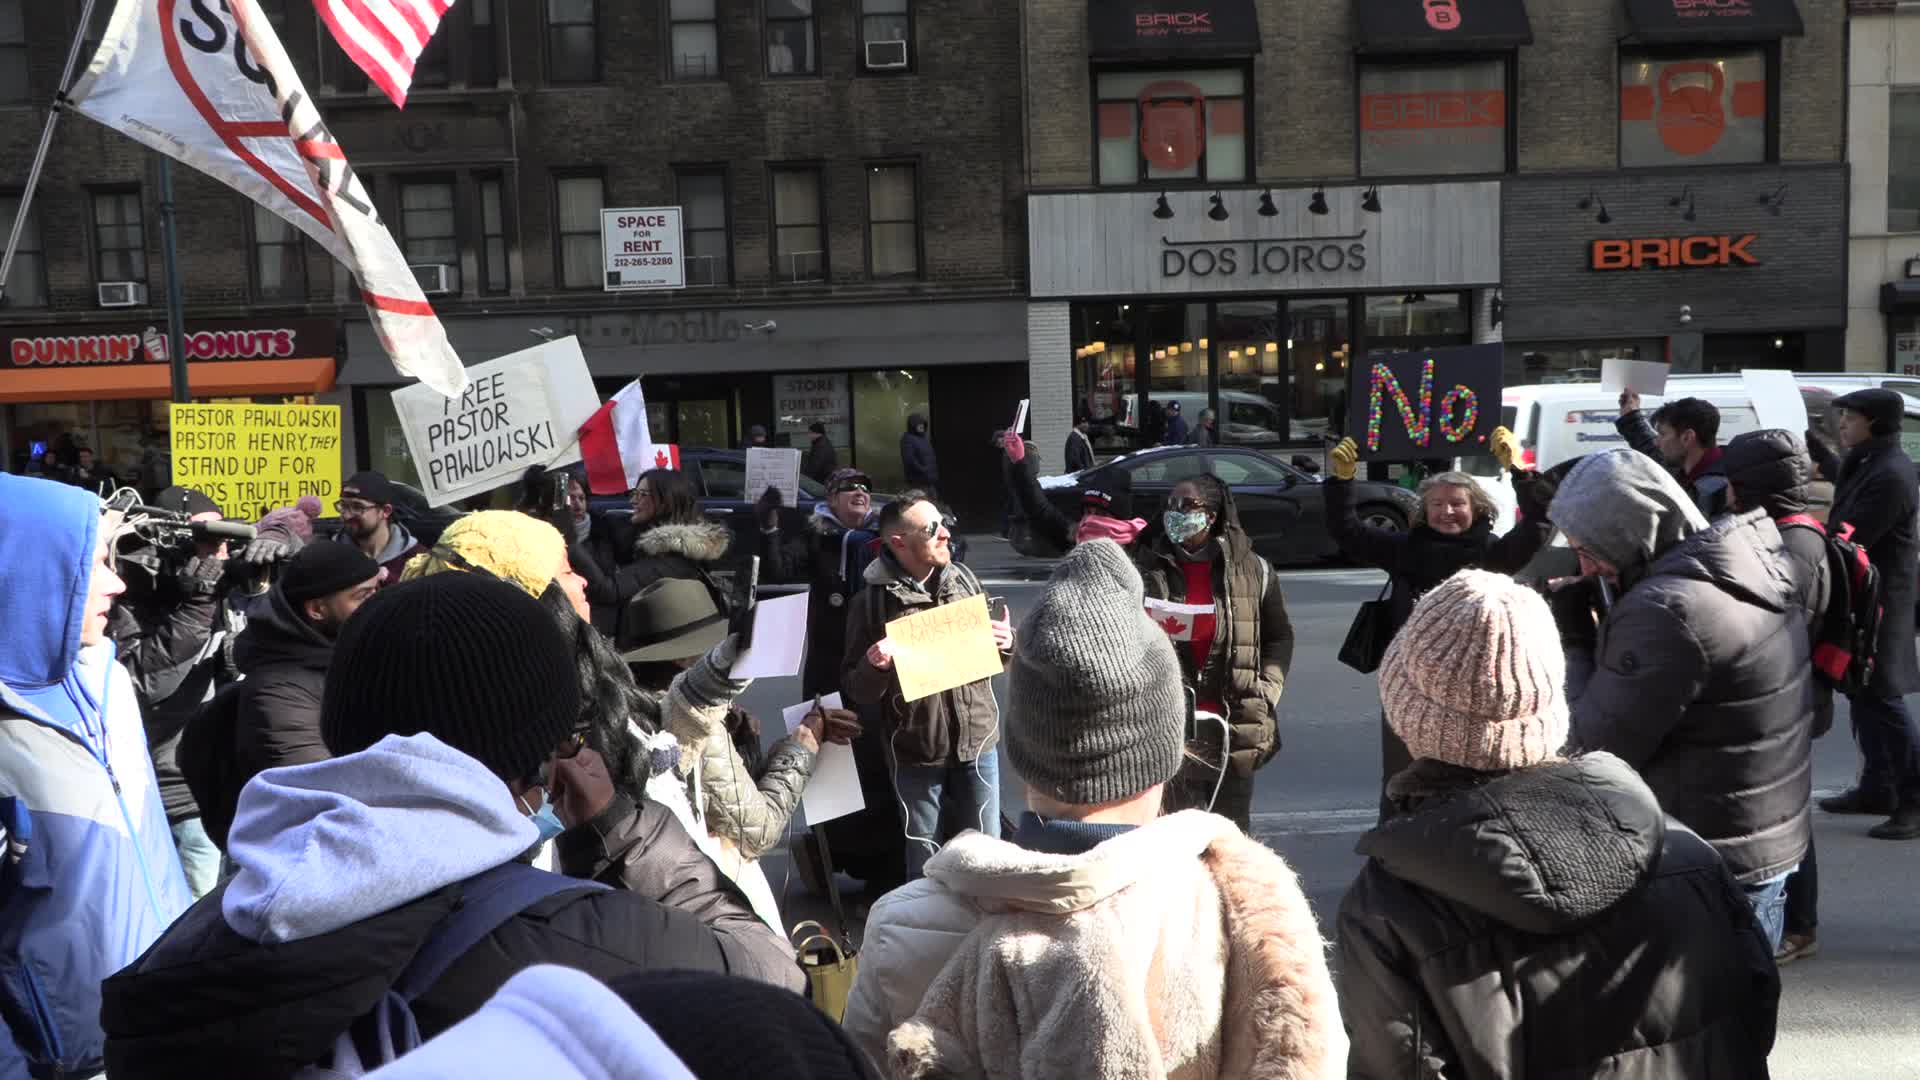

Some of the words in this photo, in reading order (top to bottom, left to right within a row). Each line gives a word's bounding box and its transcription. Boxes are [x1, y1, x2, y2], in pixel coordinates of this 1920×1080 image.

[1135, 12, 1211, 25] BRICK
[1136, 28, 1168, 36] NEW
[1176, 26, 1213, 34] YORK
[1369, 94, 1496, 124] BRICK
[617, 215, 666, 229] SPACE
[633, 230, 651, 238] FOR
[623, 240, 662, 253] RENT
[1592, 234, 1762, 269] BRICK
[614, 257, 673, 267] 212-265-2280
[1162, 247, 1237, 278] DOS
[1250, 240, 1367, 275] TOROS
[10, 334, 140, 366] DUNKIN'
[1367, 358, 1486, 451] No.
[175, 408, 235, 426] PASTOR
[243, 409, 337, 428] PAWLOWSKI
[428, 402, 510, 452] PASTOR
[175, 431, 236, 451] PASTOR
[248, 432, 308, 452] HENRY,
[310, 435, 338, 449] THEY
[428, 420, 555, 490] PAWLOWSKI
[177, 456, 239, 477] STAND
[244, 456, 268, 476] UP
[279, 456, 316, 475] FOR
[235, 480, 289, 501] TRUTH
[298, 479, 332, 497] AND
